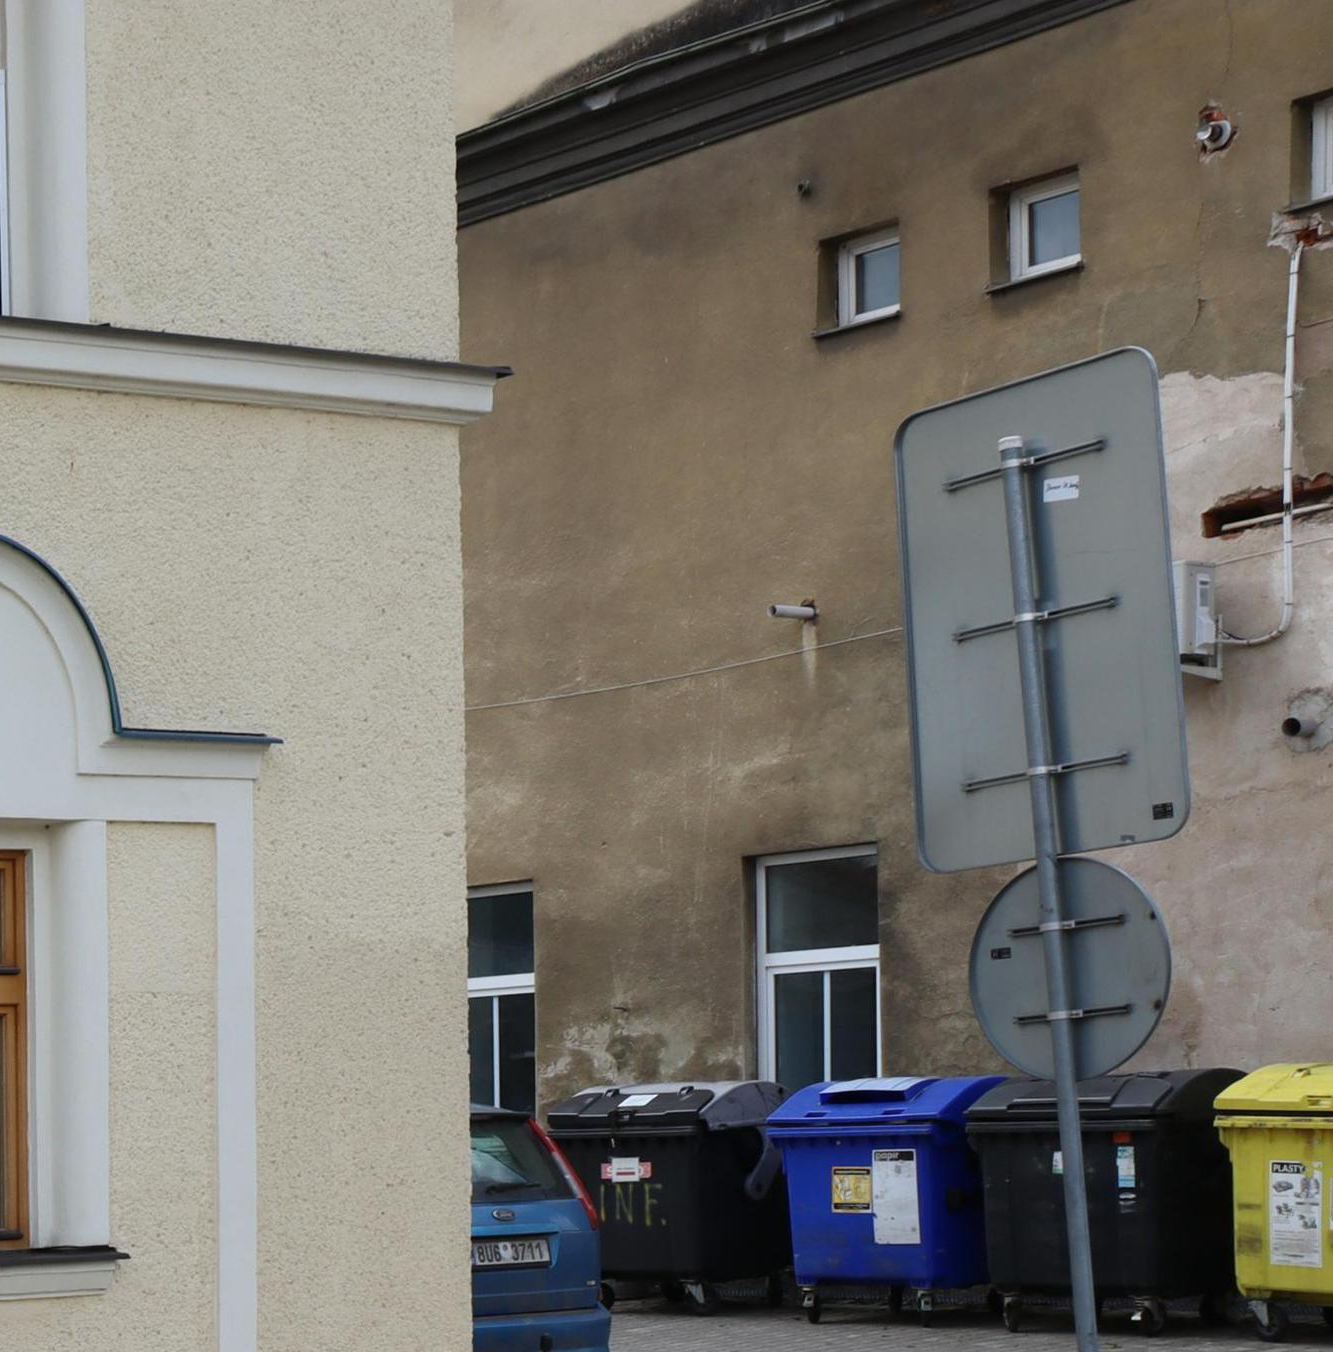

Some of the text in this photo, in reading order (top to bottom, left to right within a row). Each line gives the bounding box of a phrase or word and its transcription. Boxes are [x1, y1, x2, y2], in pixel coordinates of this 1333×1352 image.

[1273, 1163, 1304, 1173] PLASTY
[476, 1241, 545, 1263] 8U6 3711
